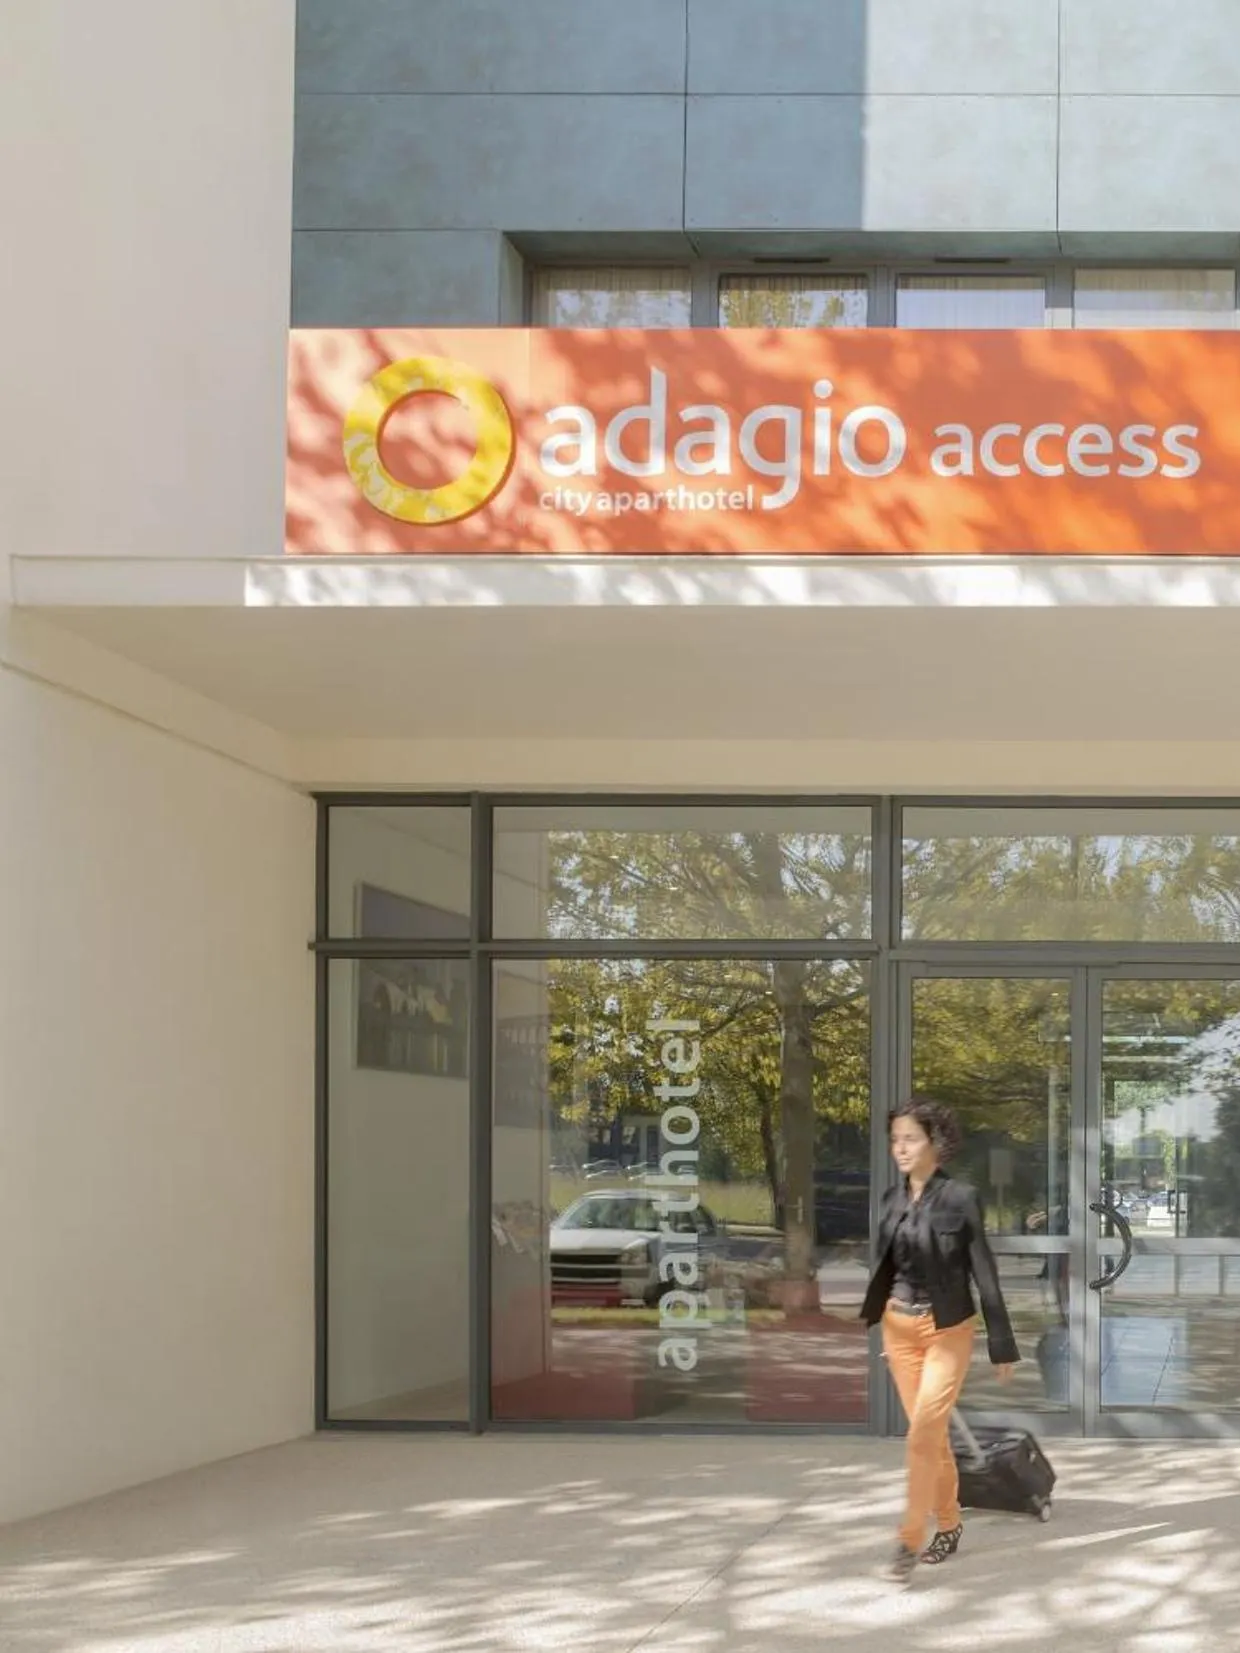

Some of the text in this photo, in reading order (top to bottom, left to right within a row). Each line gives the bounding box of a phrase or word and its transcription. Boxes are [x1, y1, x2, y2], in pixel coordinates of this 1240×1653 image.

[540, 366, 1201, 510] adagio access
[596, 484, 754, 515] aparthotel
[646, 1018, 711, 1372] aparthotel
